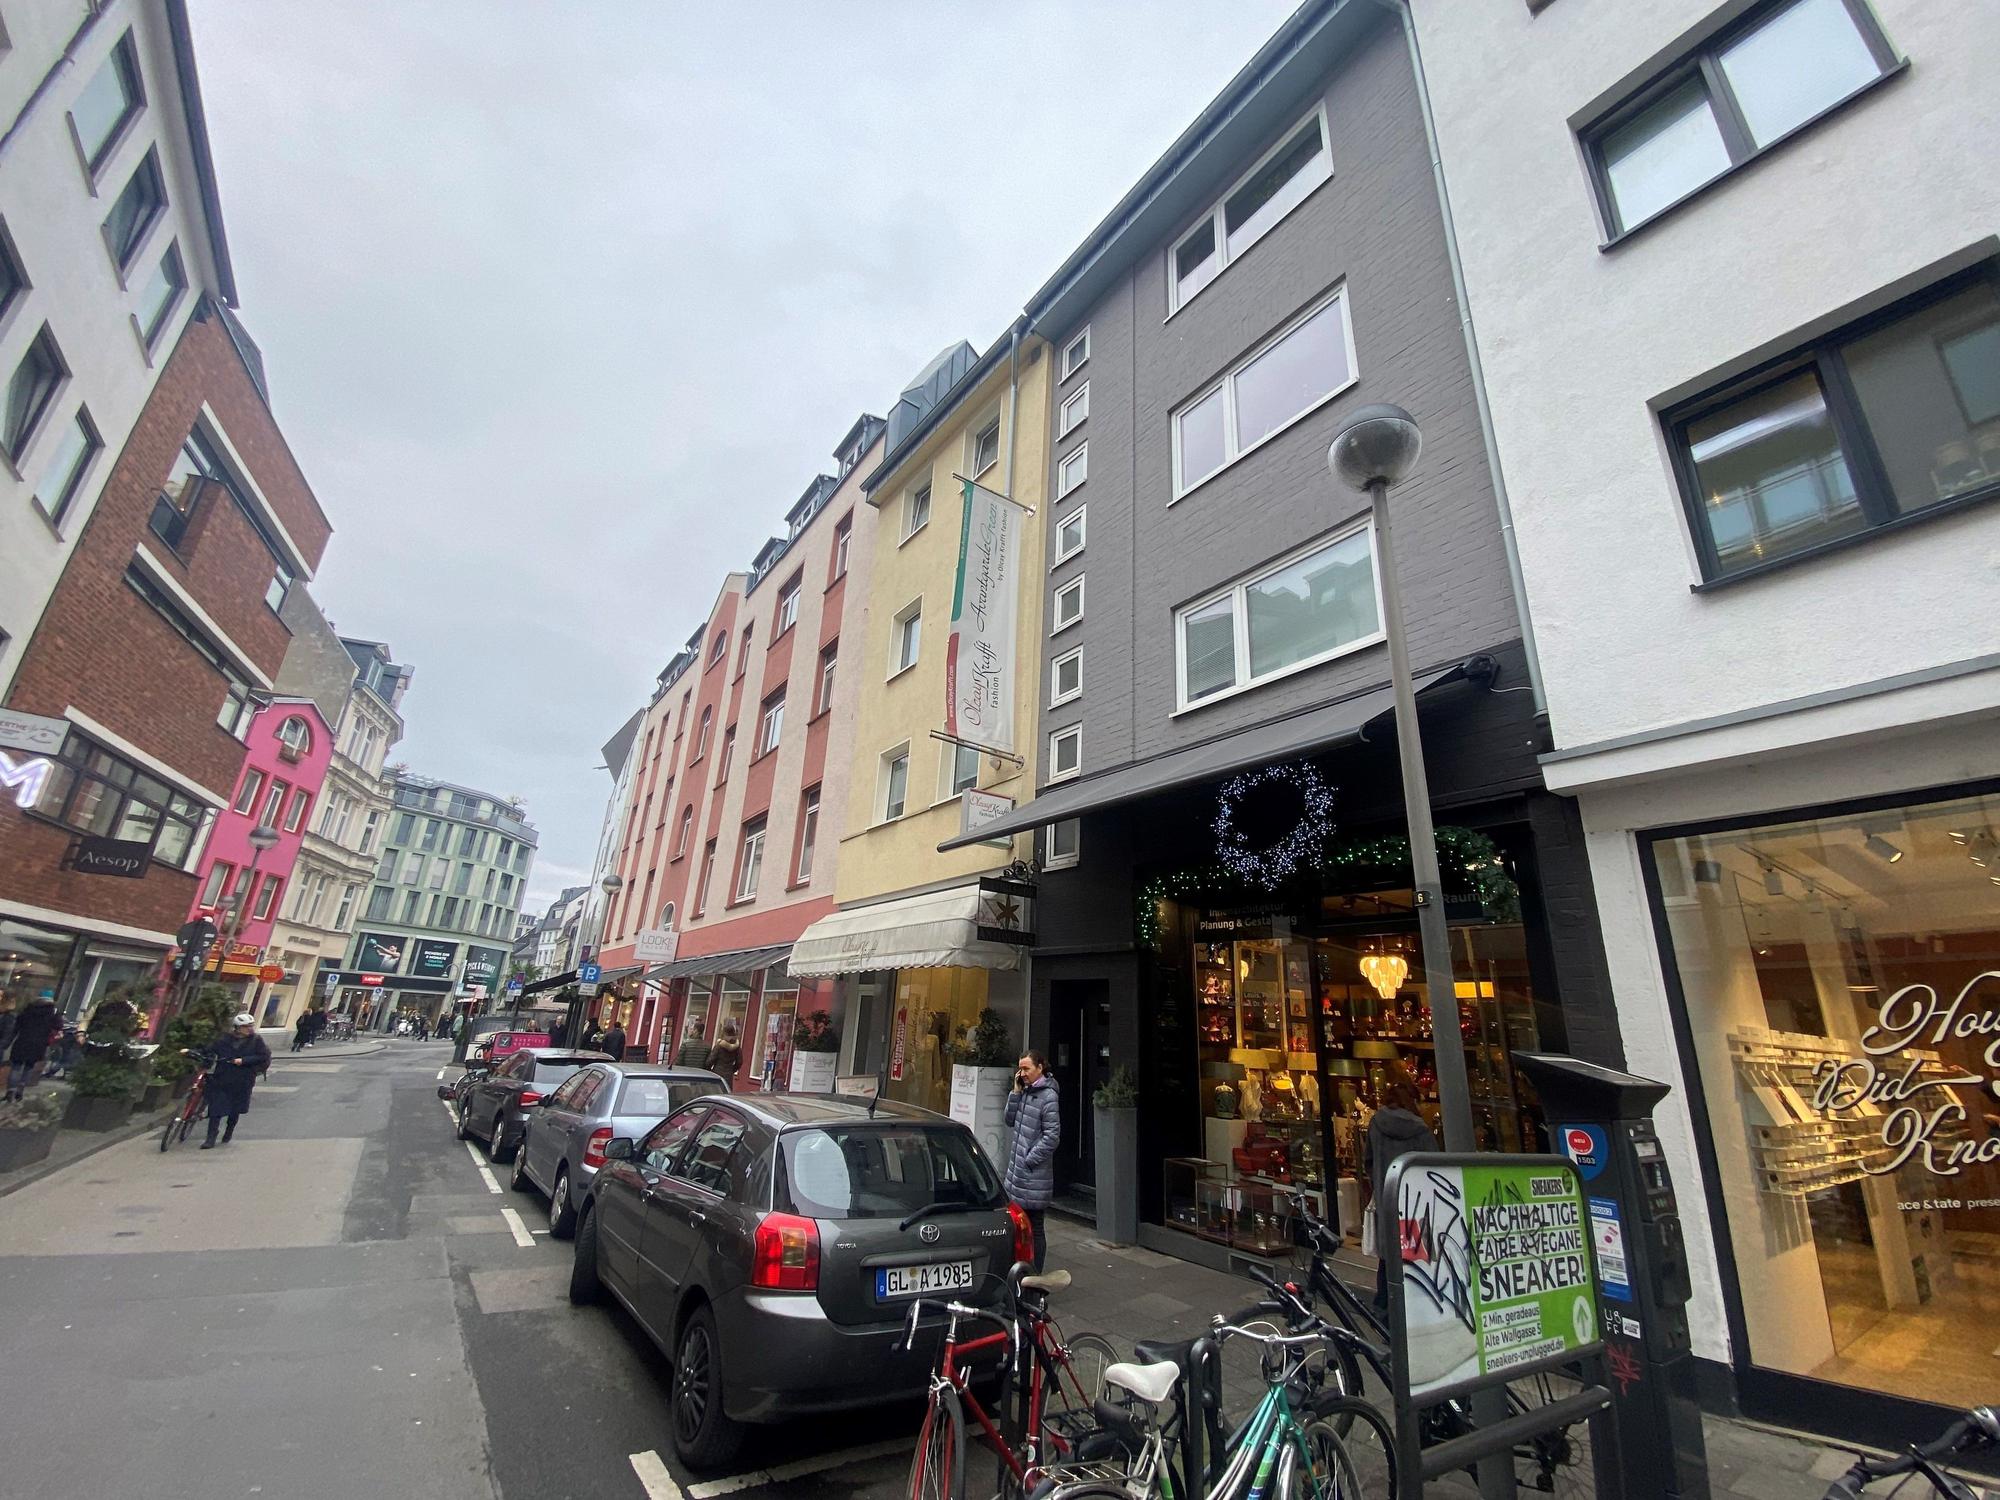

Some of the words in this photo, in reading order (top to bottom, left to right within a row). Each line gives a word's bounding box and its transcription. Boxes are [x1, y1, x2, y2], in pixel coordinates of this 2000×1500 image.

[990, 677, 1000, 708] fashion
[79, 850, 139, 872] Aesop
[1417, 893, 1424, 903] 6
[1200, 919, 1235, 930] Planung
[1236, 918, 1243, 928] &
[1812, 1058, 1984, 1110] Did
[1531, 1178, 1563, 1196] SNEAKERS
[1472, 1202, 1578, 1234] NACHHALTIGE
[1897, 1201, 1921, 1210] ace
[1923, 1200, 1933, 1210] &
[1933, 1199, 1961, 1209] tate
[1476, 1236, 1516, 1263] FAIRE
[1520, 1236, 1530, 1255] &
[1534, 1230, 1582, 1254] VEGANE
[888, 1270, 908, 1293] GL
[920, 1268, 929, 1289] A
[933, 1264, 970, 1288] 1985
[1479, 1254, 1587, 1302] SNEAKER!
[1483, 1315, 1488, 1326] 2
[1489, 1312, 1505, 1325] Min.
[1505, 1304, 1541, 1325] geradeaus
[1485, 1334, 1500, 1348] Alte
[1501, 1326, 1537, 1346] Wallgasse
[1537, 1323, 1542, 1335] 5
[1486, 1339, 1565, 1370] sneakers-unplugged.de
